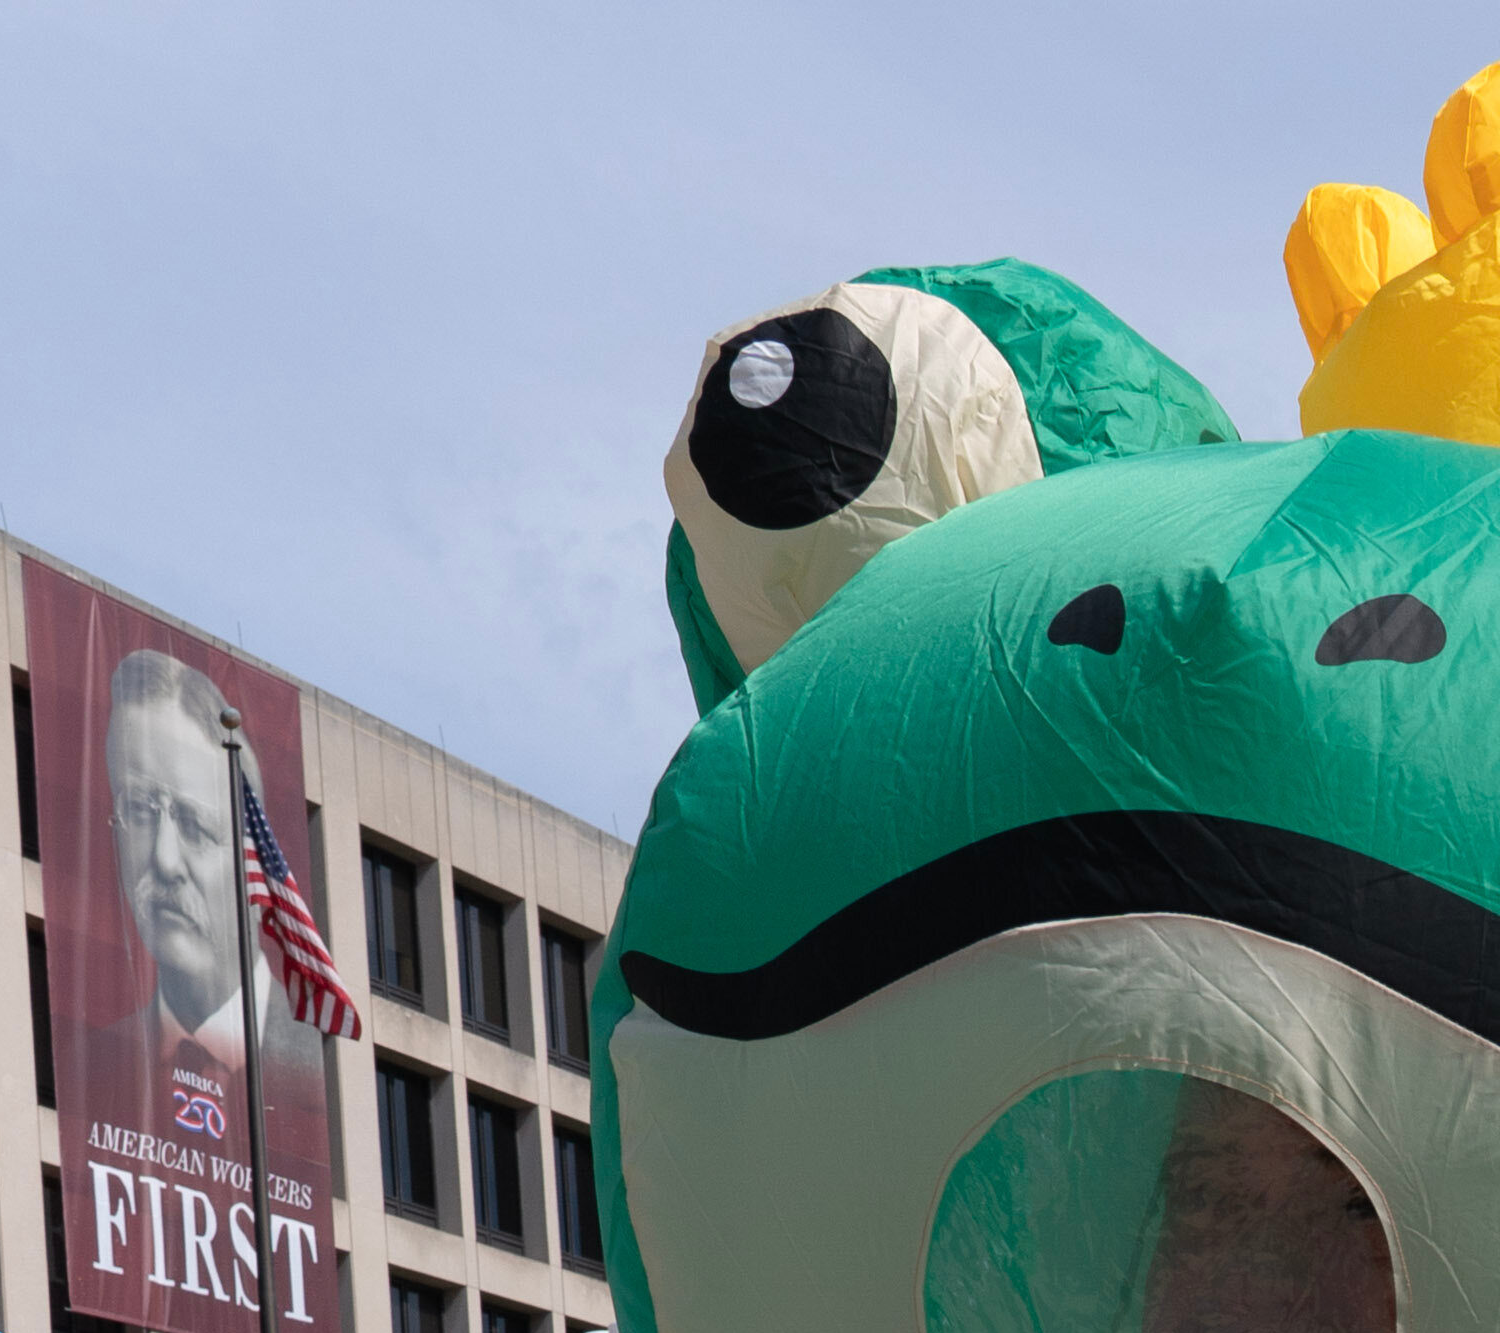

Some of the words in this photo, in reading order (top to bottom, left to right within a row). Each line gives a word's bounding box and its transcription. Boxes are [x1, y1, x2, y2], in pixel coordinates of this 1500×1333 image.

[172, 1067, 224, 1098] AMERICA
[173, 1088, 226, 1140] 250
[87, 1122, 206, 1176] AMERICAN
[87, 1160, 319, 1324] FIRST
